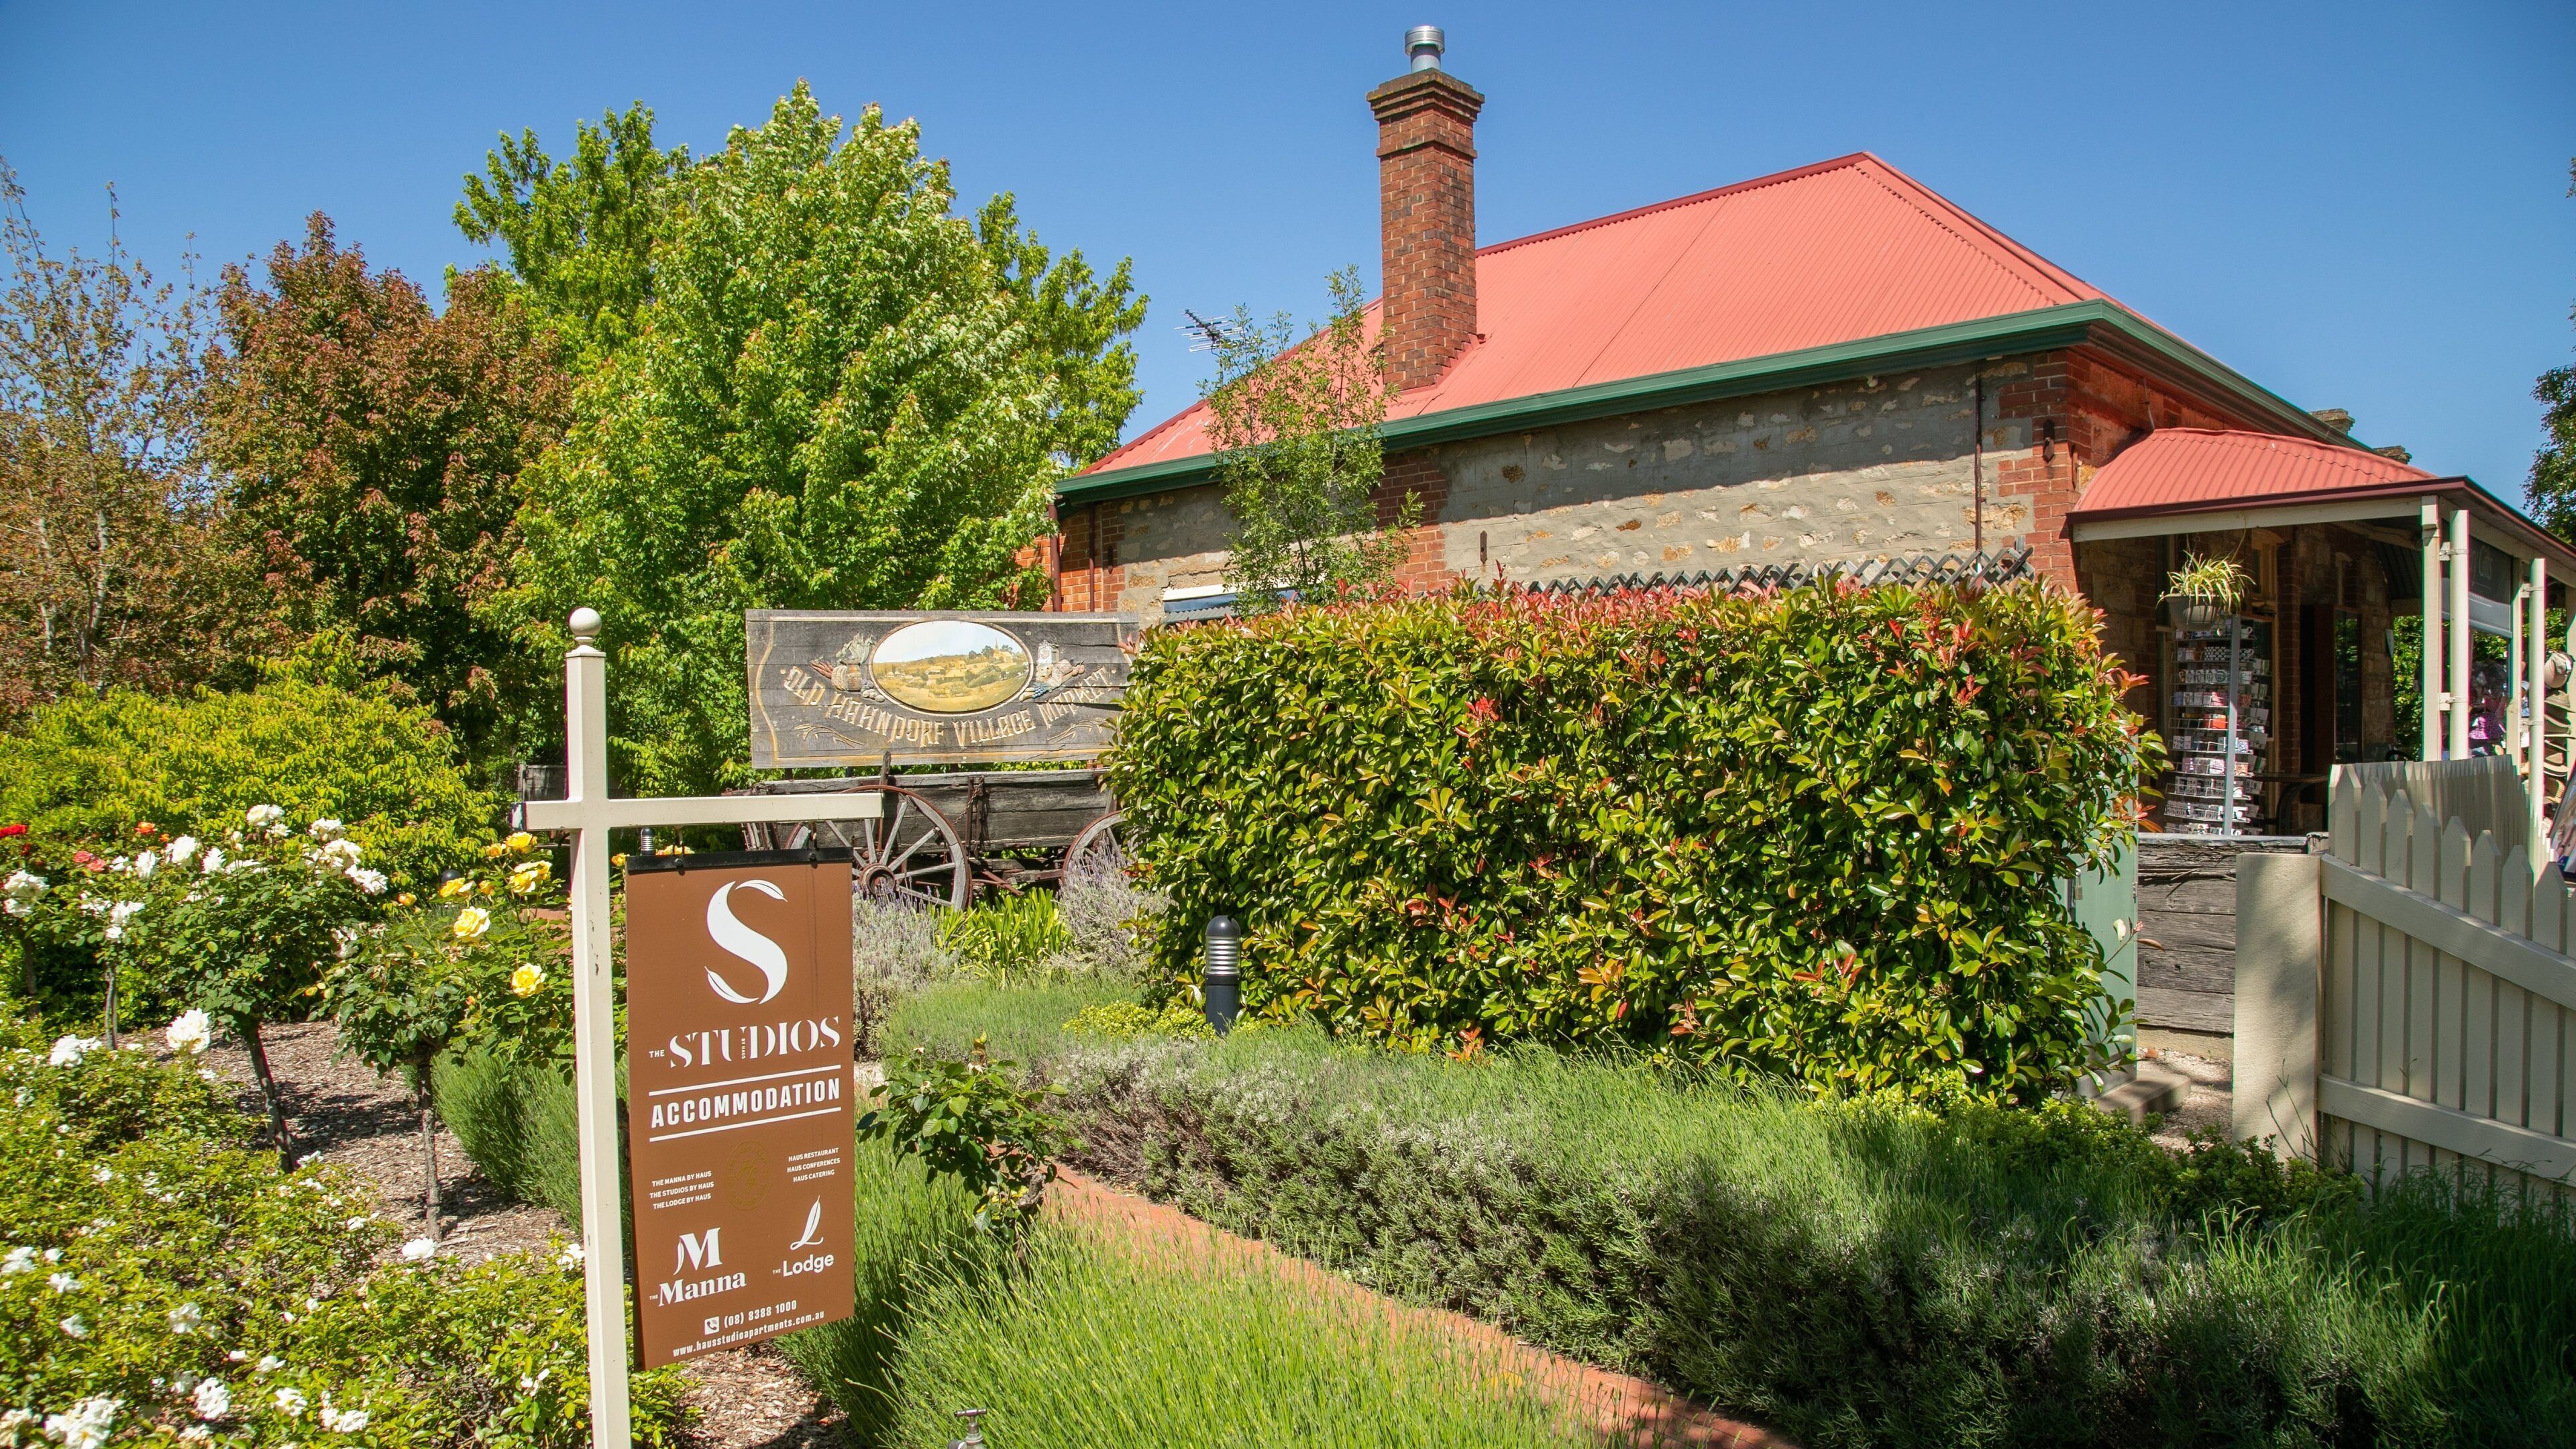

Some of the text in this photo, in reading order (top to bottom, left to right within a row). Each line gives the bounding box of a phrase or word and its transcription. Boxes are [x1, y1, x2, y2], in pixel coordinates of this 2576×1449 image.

[784, 665, 1110, 749] OLD HAHNDORF VILLAGE MARKET
[648, 1016, 841, 1069] THE STUDIOS
[651, 1077, 840, 1128] ACCOMMODATION
[787, 1157, 841, 1173] HAUS CONFERENCES
[788, 1147, 839, 1163] HAUS RESTAURANT
[651, 1170, 712, 1187] THE MANNA BY HAUS
[793, 1169, 835, 1183] HAUS CATERING
[649, 1181, 714, 1199] THE STUDIOS BY HAUS
[653, 1193, 712, 1210] THE LODGE BY HAUS
[783, 1254, 835, 1277] Lodge
[658, 1272, 747, 1307] Manna
[724, 1299, 797, 1329] (08) 8388 1000
[673, 1311, 824, 1357] www.hausstudioapartments.com.au
